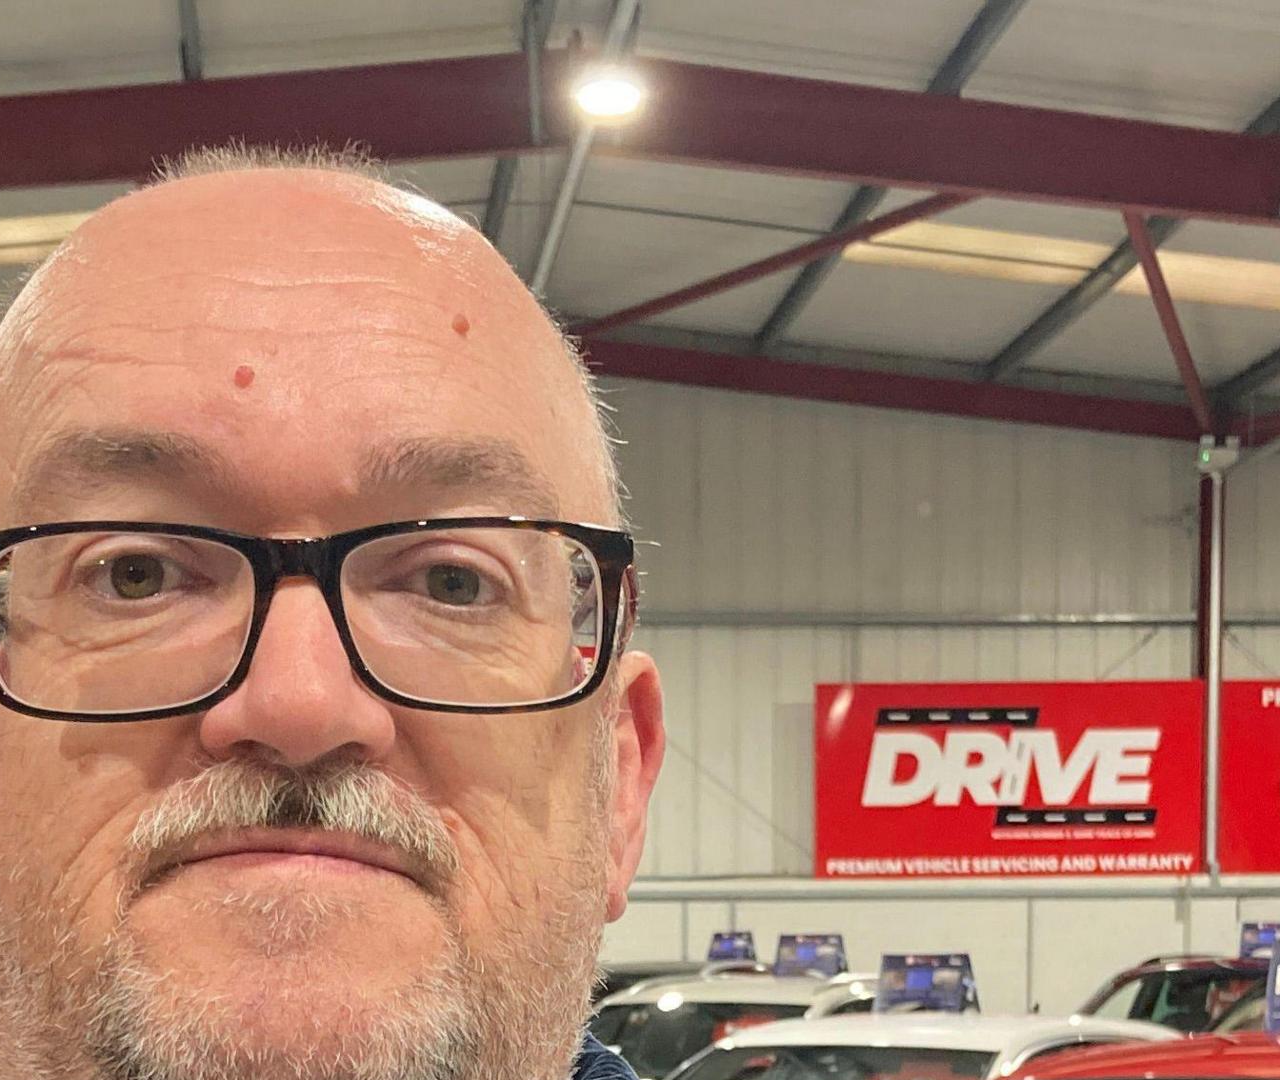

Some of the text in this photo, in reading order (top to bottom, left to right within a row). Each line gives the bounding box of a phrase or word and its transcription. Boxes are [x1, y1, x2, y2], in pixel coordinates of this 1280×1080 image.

[861, 727, 1162, 808] DRIVE
[826, 853, 1192, 875] PREMIUM VEHICLE SERVICING AND WARRANTY
